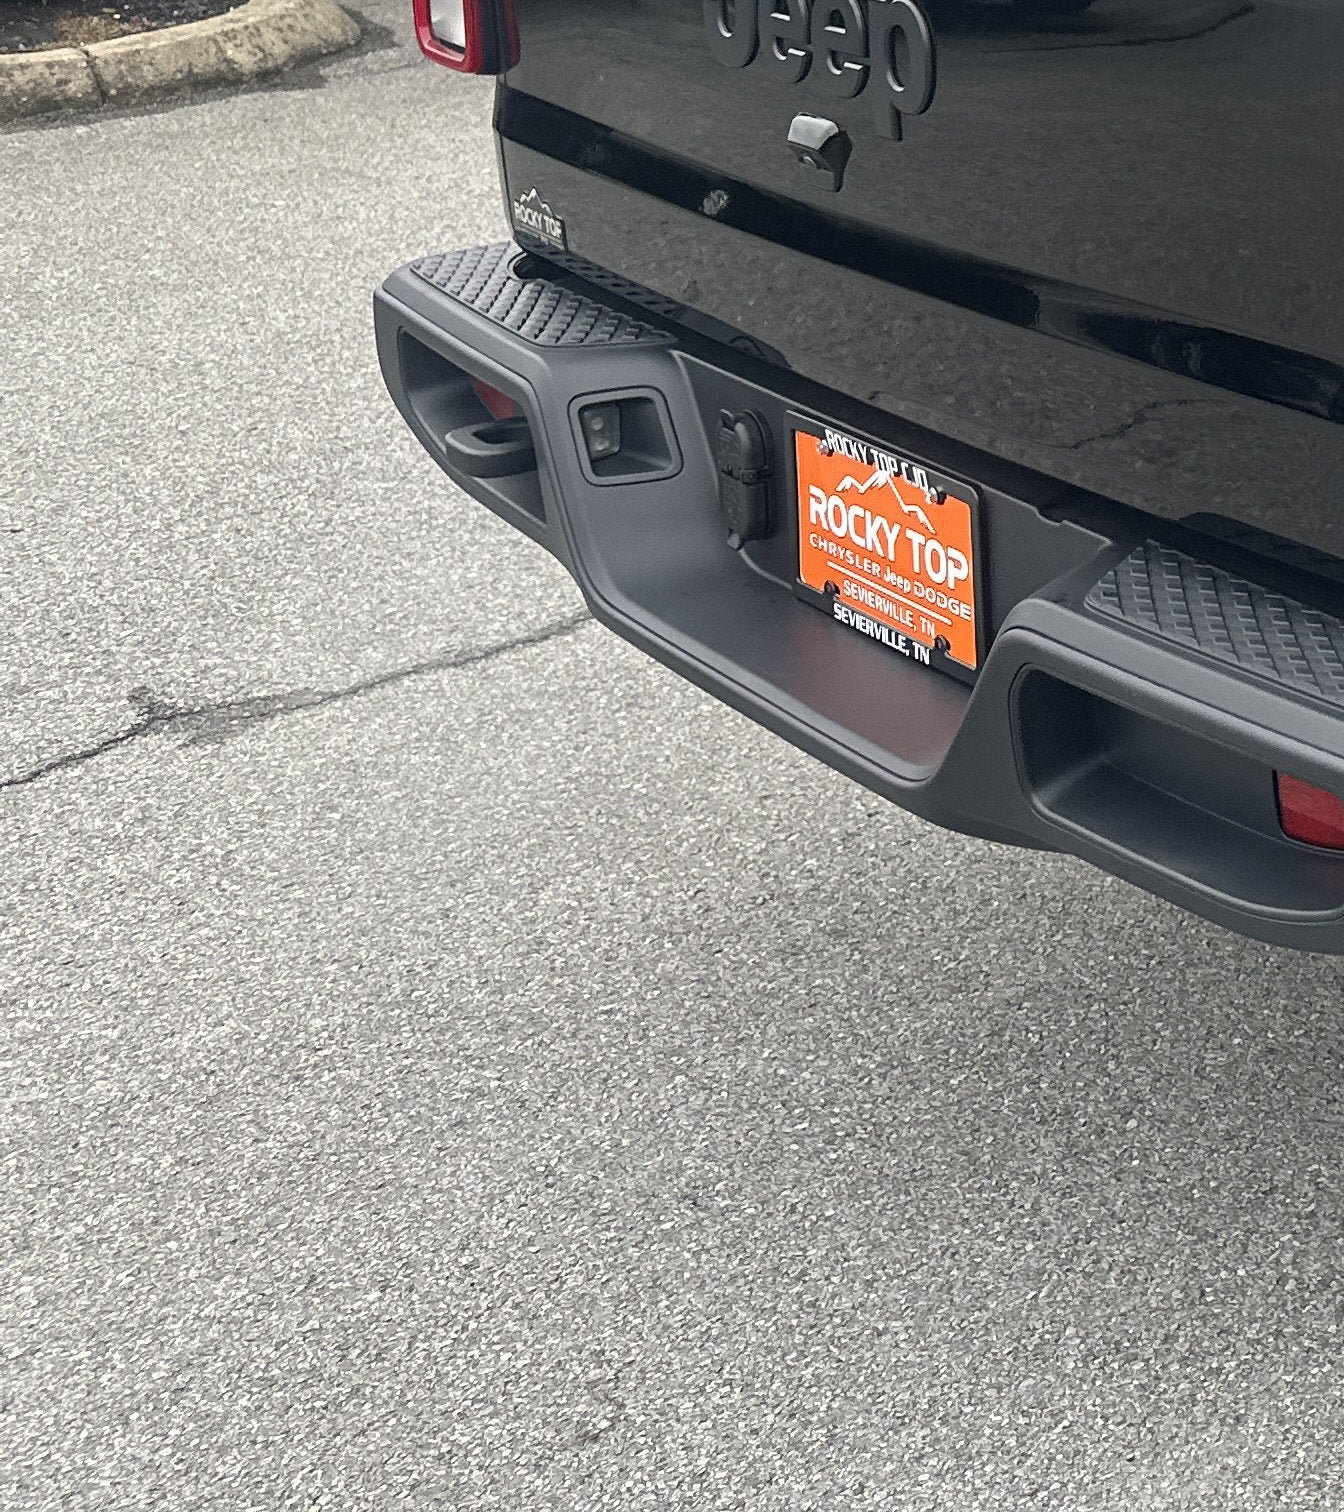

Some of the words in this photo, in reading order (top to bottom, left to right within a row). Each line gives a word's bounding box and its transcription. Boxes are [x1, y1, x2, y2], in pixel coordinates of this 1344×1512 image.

[825, 429, 868, 465] ROCKY
[871, 448, 899, 476] TOP
[809, 485, 901, 562] ROCKY
[905, 528, 968, 589] TOP
[809, 533, 881, 578] CHRYSLER
[883, 565, 911, 594] Jeep
[913, 581, 972, 621] DODGE
[843, 579, 917, 632] SEVIERVILLE,
[919, 613, 936, 637] TN
[833, 603, 909, 657] SEVIERVILLE,
[912, 641, 930, 665] TN
